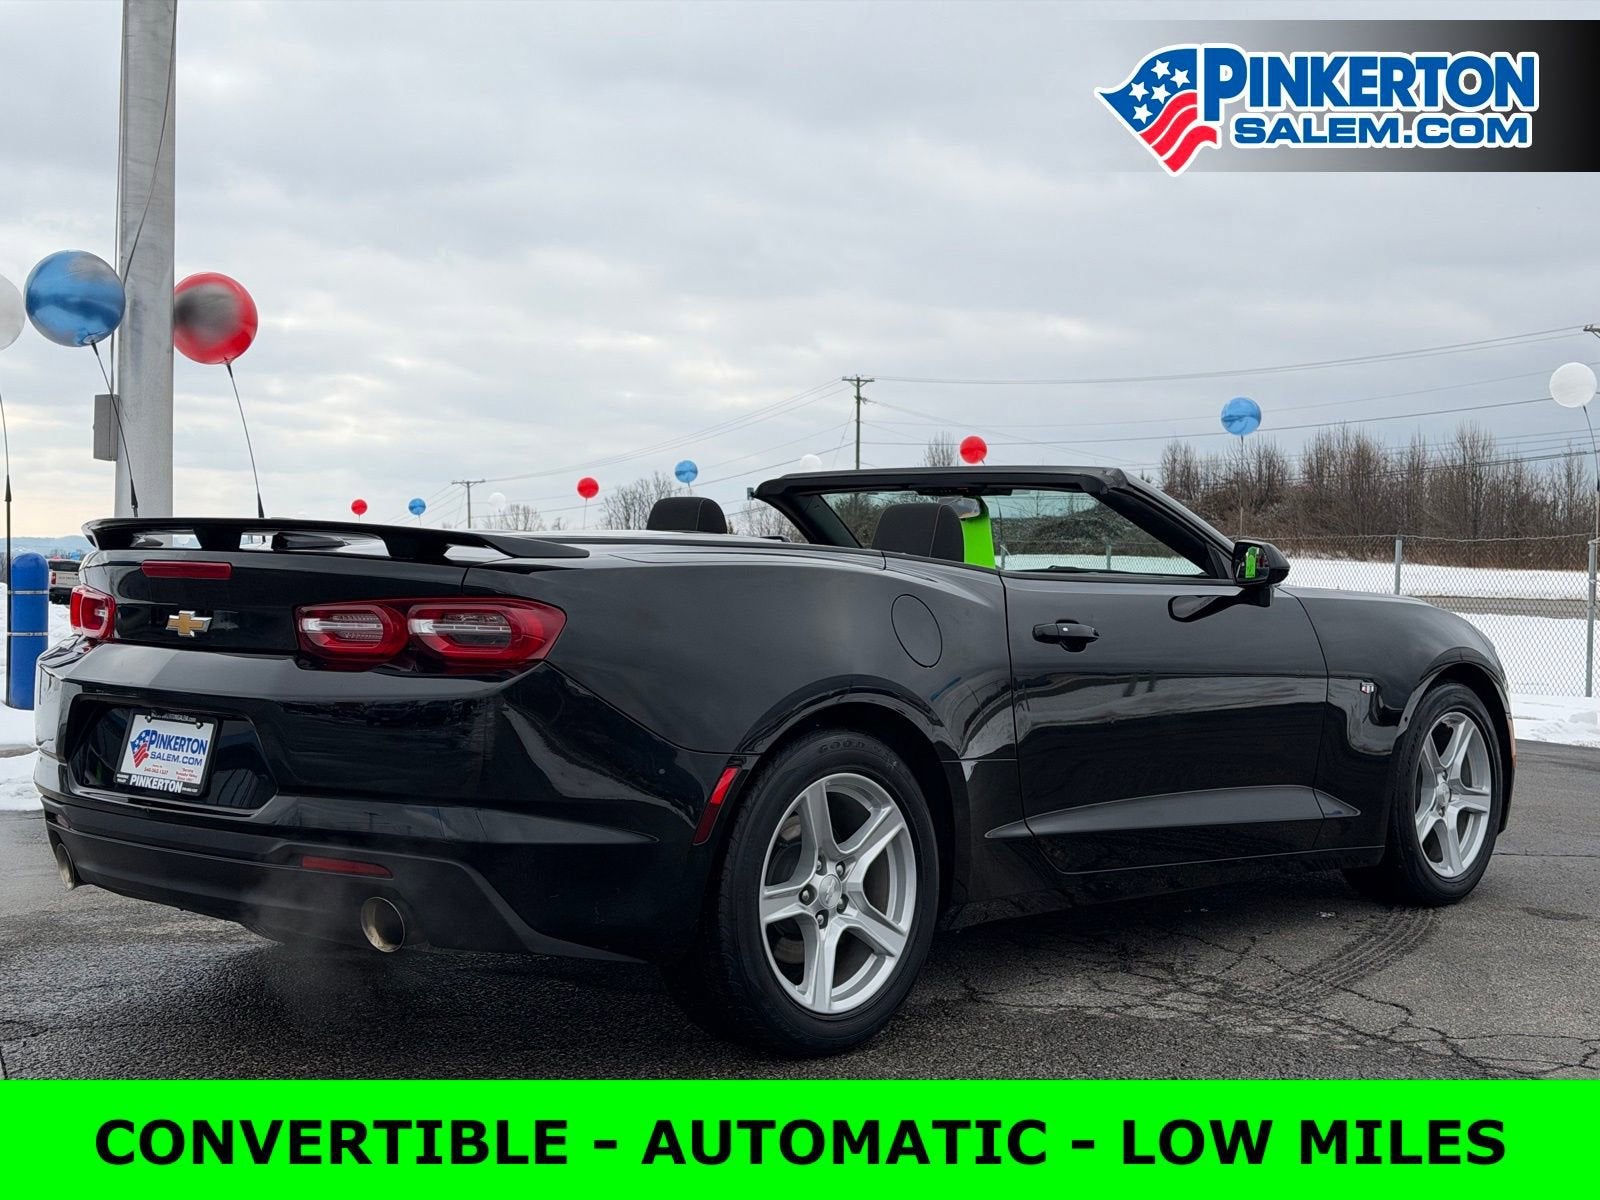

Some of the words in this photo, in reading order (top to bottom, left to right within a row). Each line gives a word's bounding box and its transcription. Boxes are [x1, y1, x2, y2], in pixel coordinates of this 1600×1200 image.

[149, 730, 208, 755] PINKERTON
[150, 752, 202, 766] SALEM.COM
[129, 775, 183, 793] PINKERTON
